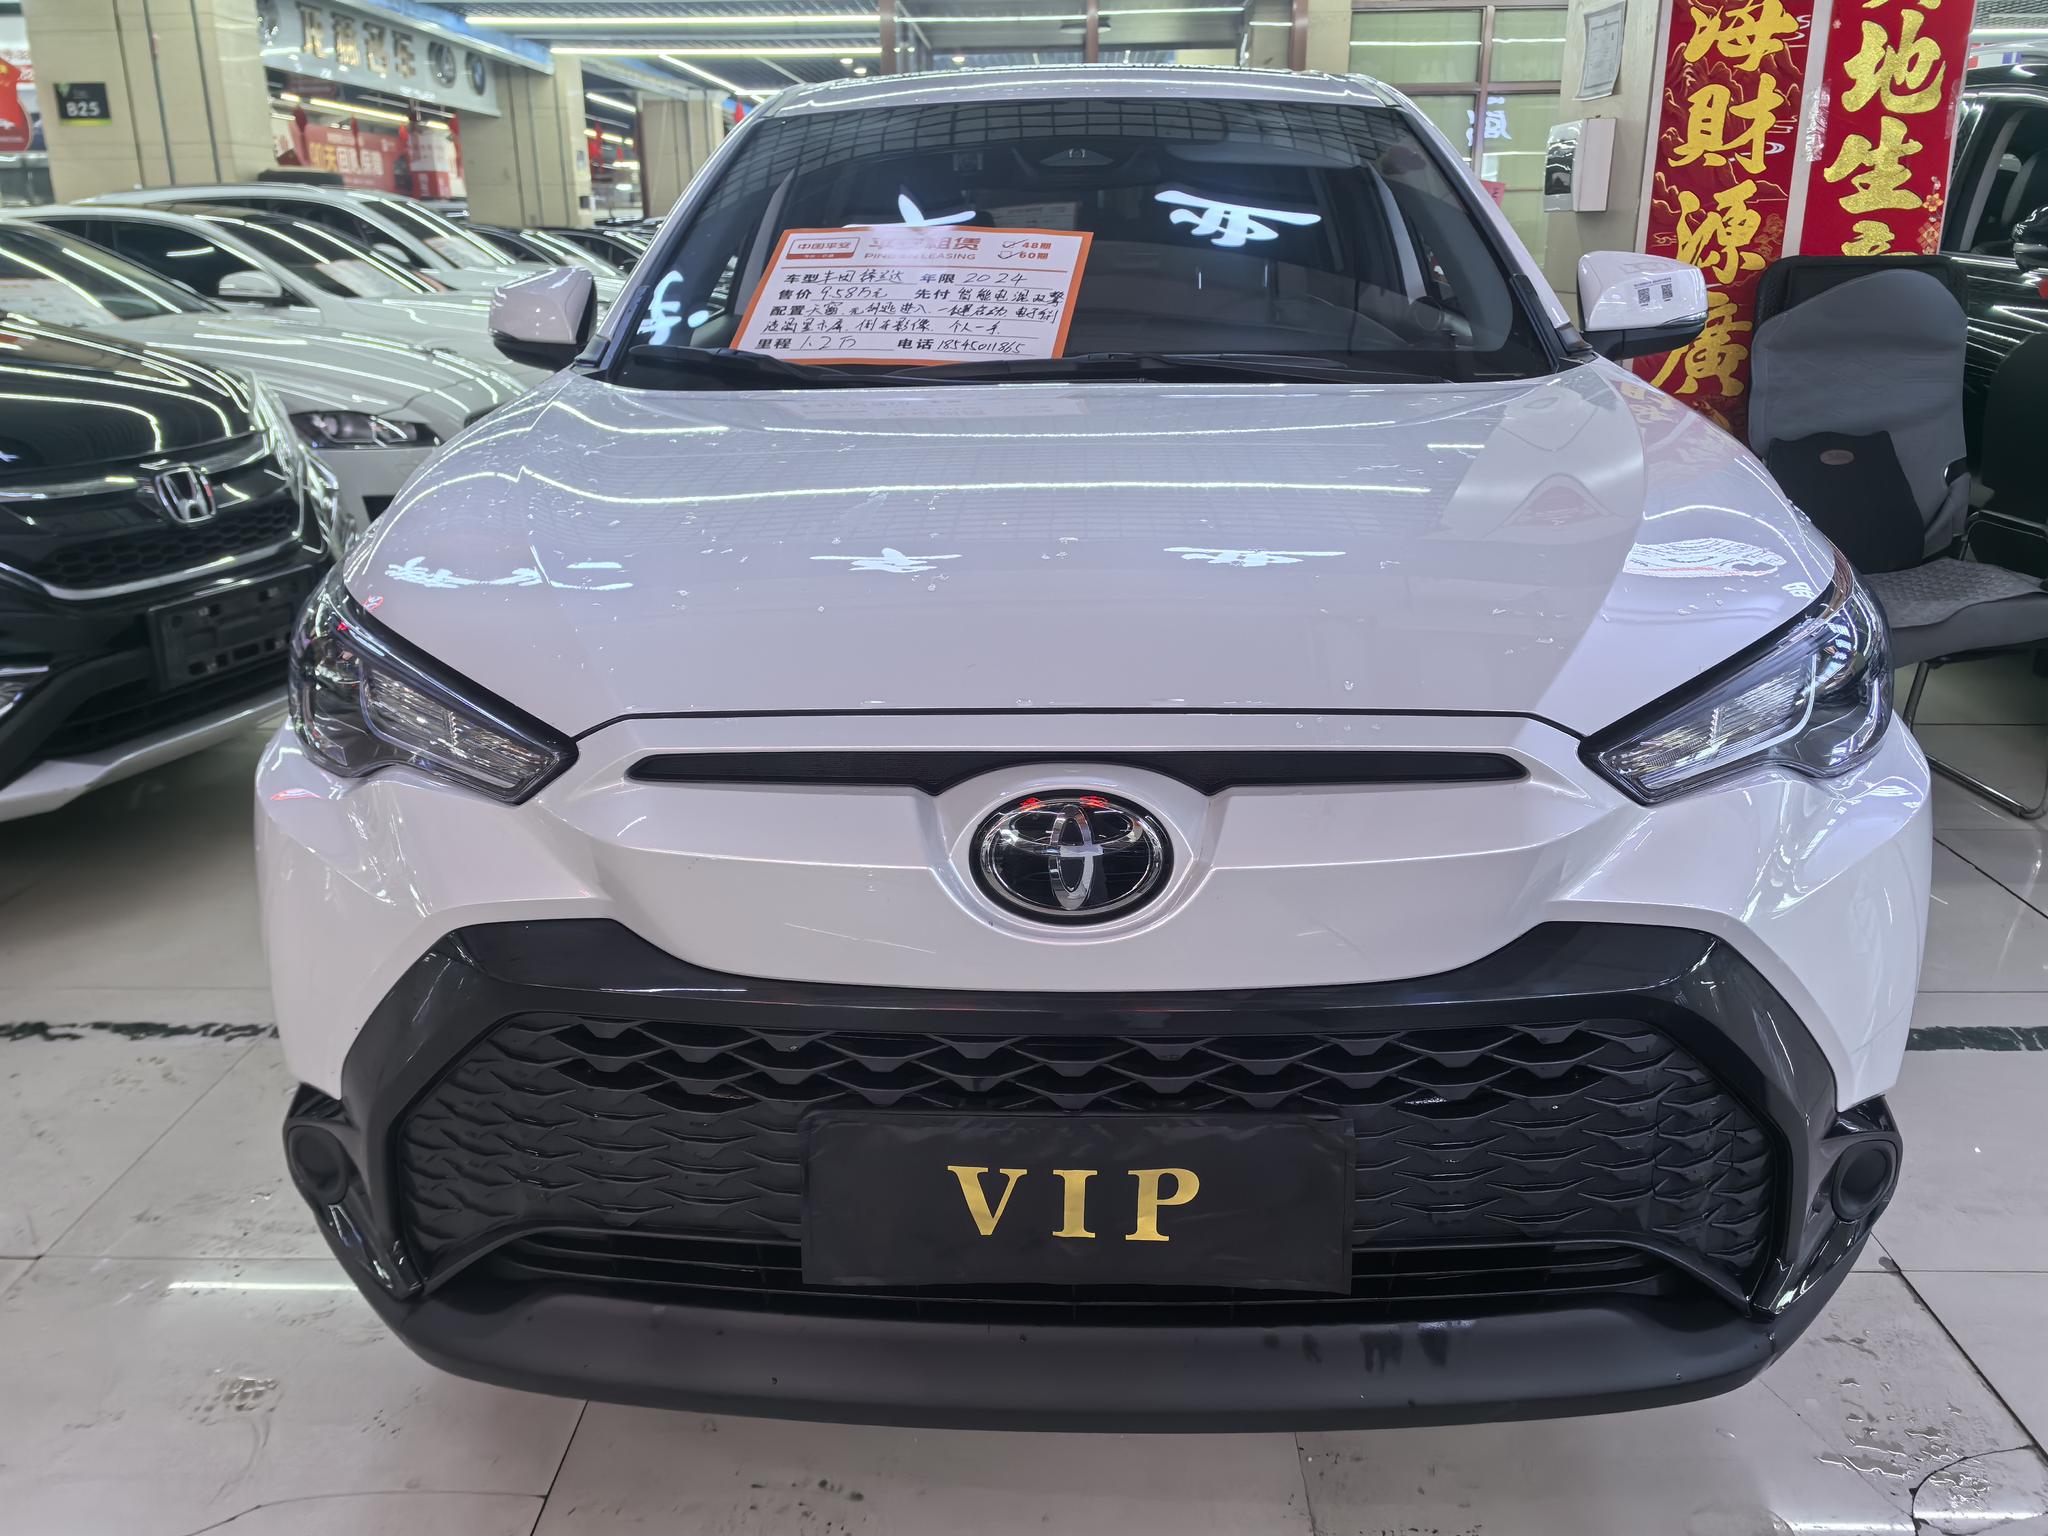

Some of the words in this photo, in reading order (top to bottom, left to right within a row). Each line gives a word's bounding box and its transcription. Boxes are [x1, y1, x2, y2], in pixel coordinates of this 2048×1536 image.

[65, 101, 100, 117] B25
[797, 242, 851, 250] 中国平安
[1022, 242, 1052, 250] 48期
[784, 274, 819, 284] 车型
[919, 274, 956, 284] 年限
[962, 273, 1028, 287] 2024
[778, 289, 813, 300] 售价
[914, 289, 951, 300] 先付
[769, 305, 806, 317] 配置
[754, 338, 793, 350] 里程
[897, 338, 934, 350] 电话
[937, 338, 1027, 354] 18545011865
[947, 1165, 1201, 1241] VIP
